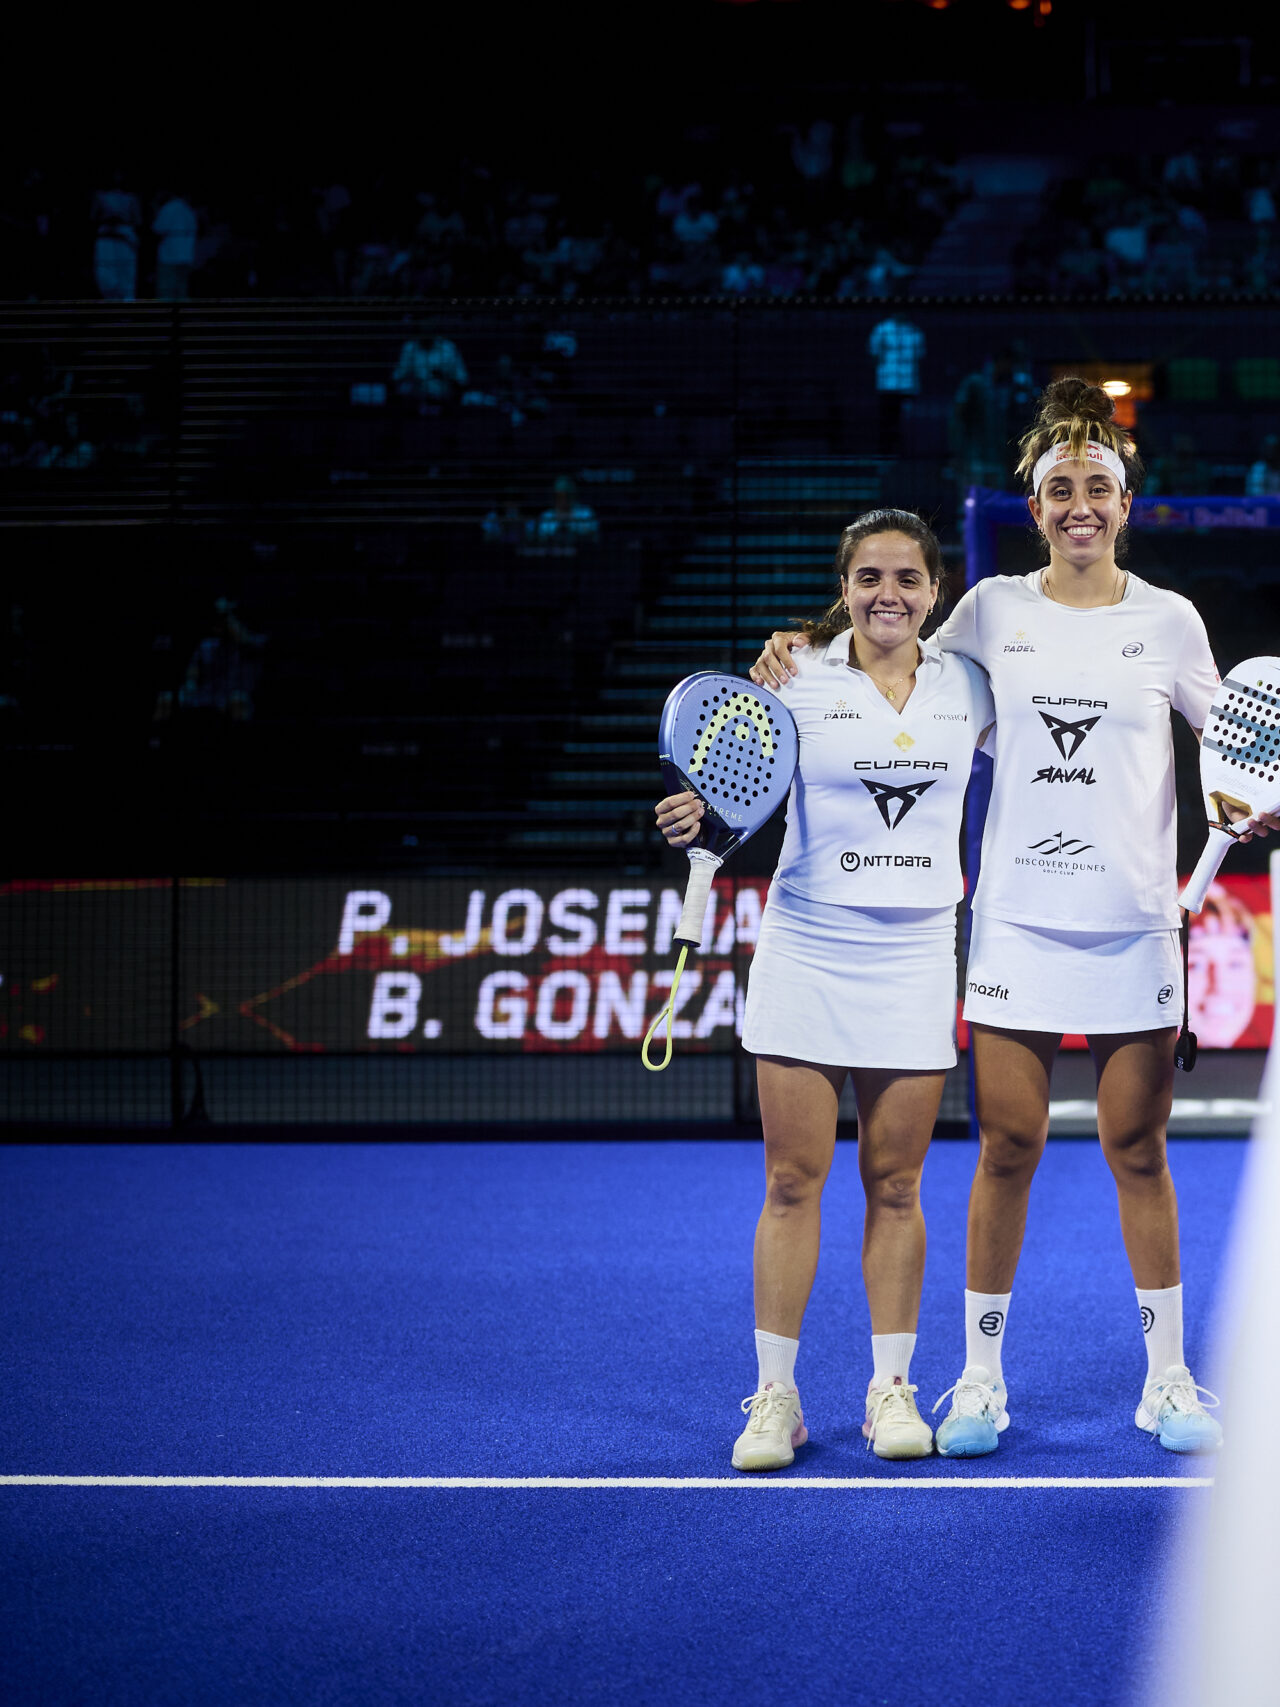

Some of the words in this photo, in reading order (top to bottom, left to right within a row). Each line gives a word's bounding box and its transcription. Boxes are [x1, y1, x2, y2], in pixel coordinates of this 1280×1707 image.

[1003, 645, 1036, 653] PADEL
[1032, 695, 1108, 710] CUPRA
[824, 712, 862, 720] PADEL
[854, 760, 948, 771] CUPRA
[701, 801, 743, 822] EXTREME
[1015, 857, 1070, 869] DISCOVERY
[1072, 863, 1106, 873] DUNES
[338, 890, 409, 956] P.
[367, 970, 442, 1040] B.
